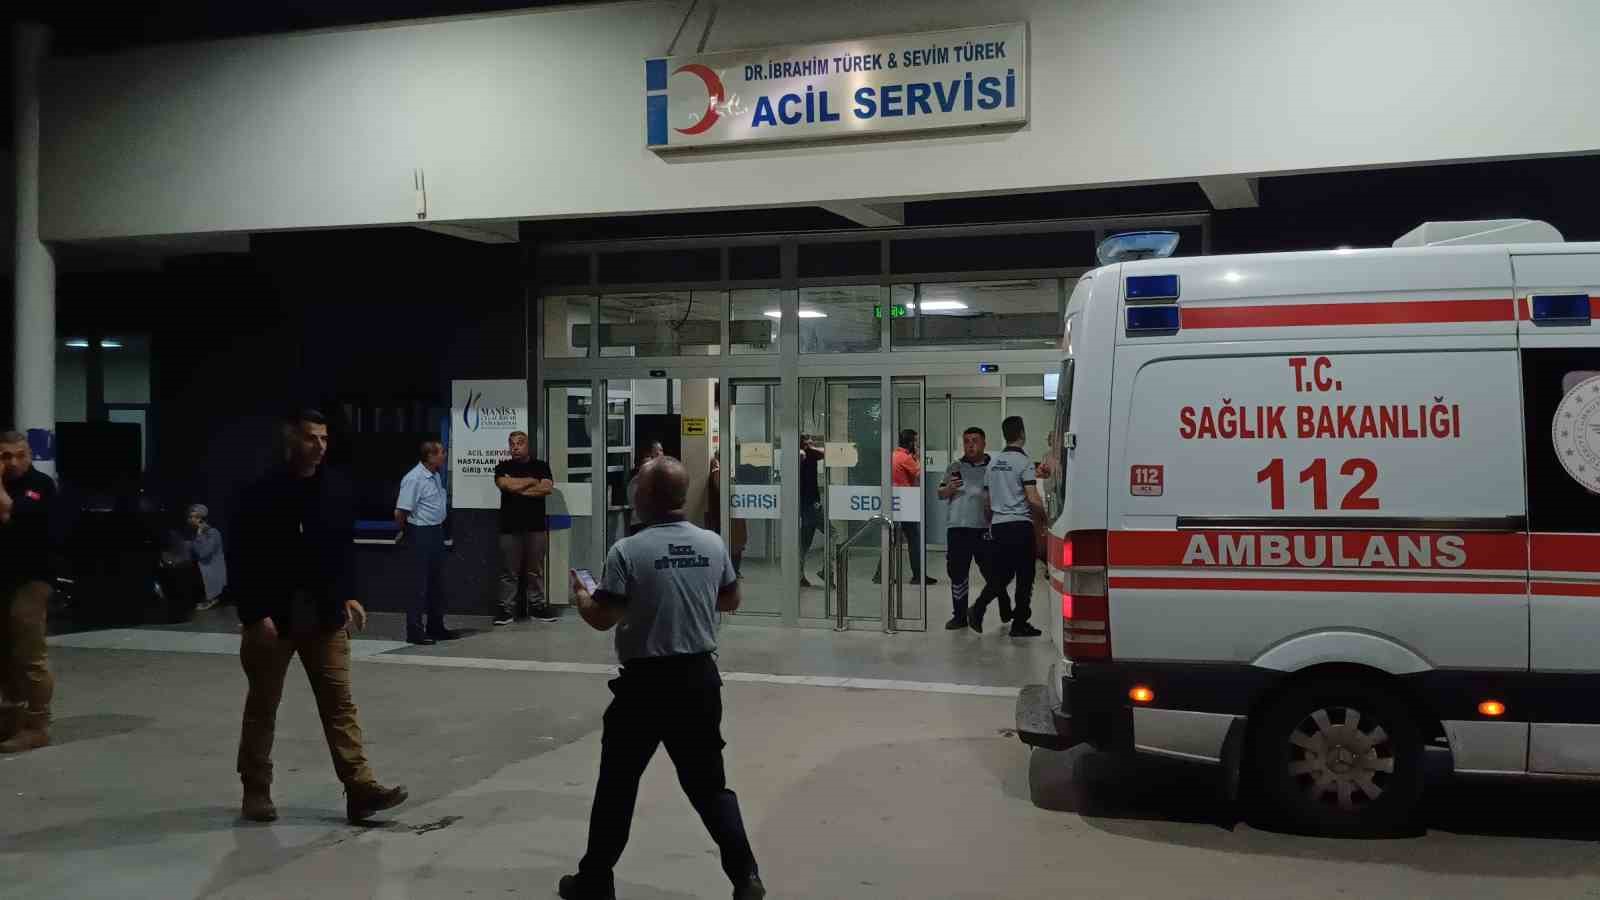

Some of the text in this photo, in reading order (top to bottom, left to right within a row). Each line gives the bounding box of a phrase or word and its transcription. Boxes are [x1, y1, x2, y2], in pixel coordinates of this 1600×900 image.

[833, 54, 882, 74] TÜREK
[887, 57, 897, 69] &
[903, 44, 949, 67] SEVİM
[954, 41, 1006, 62] TÜREK
[751, 69, 1016, 127] ACİL SERVİSİ
[1289, 356, 1342, 392] T.C.
[1179, 396, 1461, 439] SAĞLIK BAKANLIĞI
[1135, 468, 1159, 484] 112
[1256, 457, 1380, 511] 112
[850, 495, 902, 512] SEDE
[1181, 534, 1467, 569] AMBULANS
